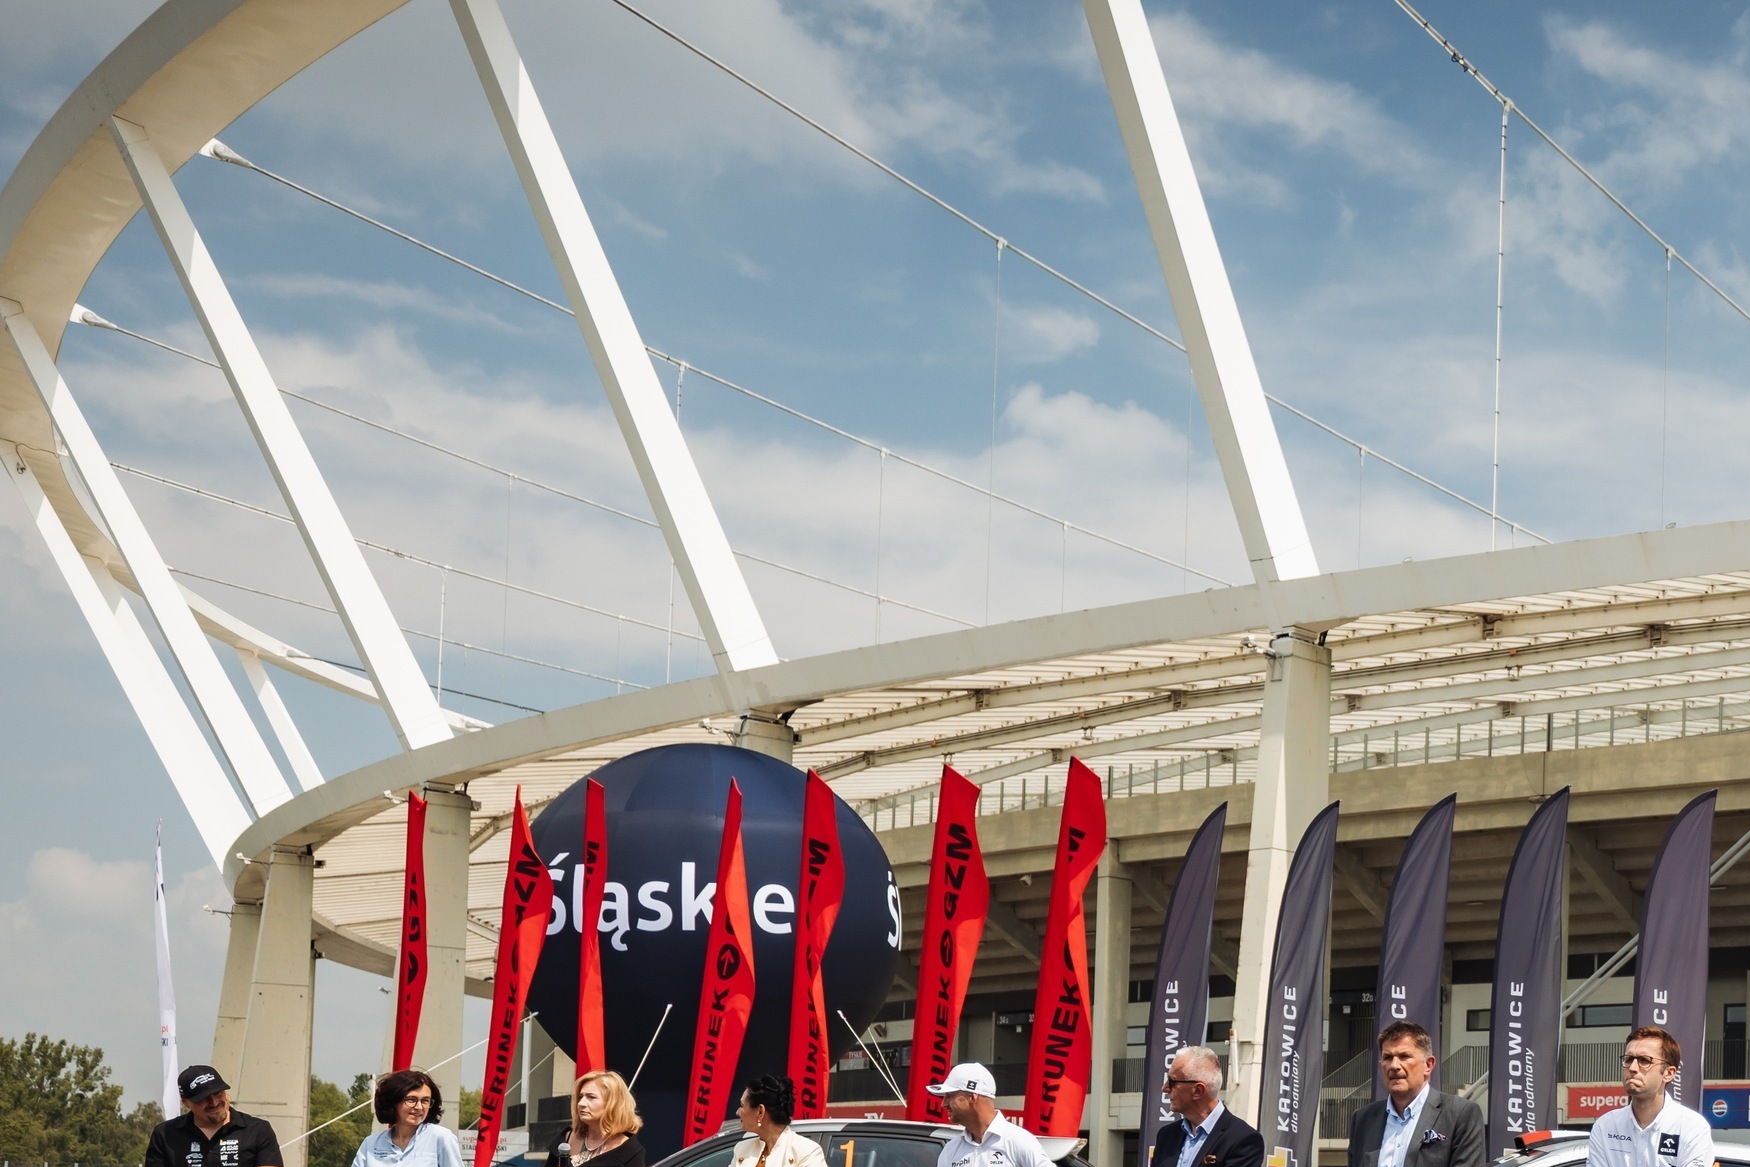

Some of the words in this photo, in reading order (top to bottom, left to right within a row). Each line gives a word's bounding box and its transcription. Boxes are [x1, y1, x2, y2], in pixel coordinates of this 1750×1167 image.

[545, 852, 795, 951] Śląske
[944, 823, 974, 921] GZM
[692, 987, 730, 1144] IERUNEK
[1039, 983, 1083, 1136] IERUNEK
[1277, 986, 1298, 1132] KATOWICE
[1292, 1050, 1301, 1109] odmiany
[1507, 981, 1524, 1133] KATOWICE
[1524, 1048, 1535, 1109] odmiany
[1290, 1109, 1299, 1133] dla
